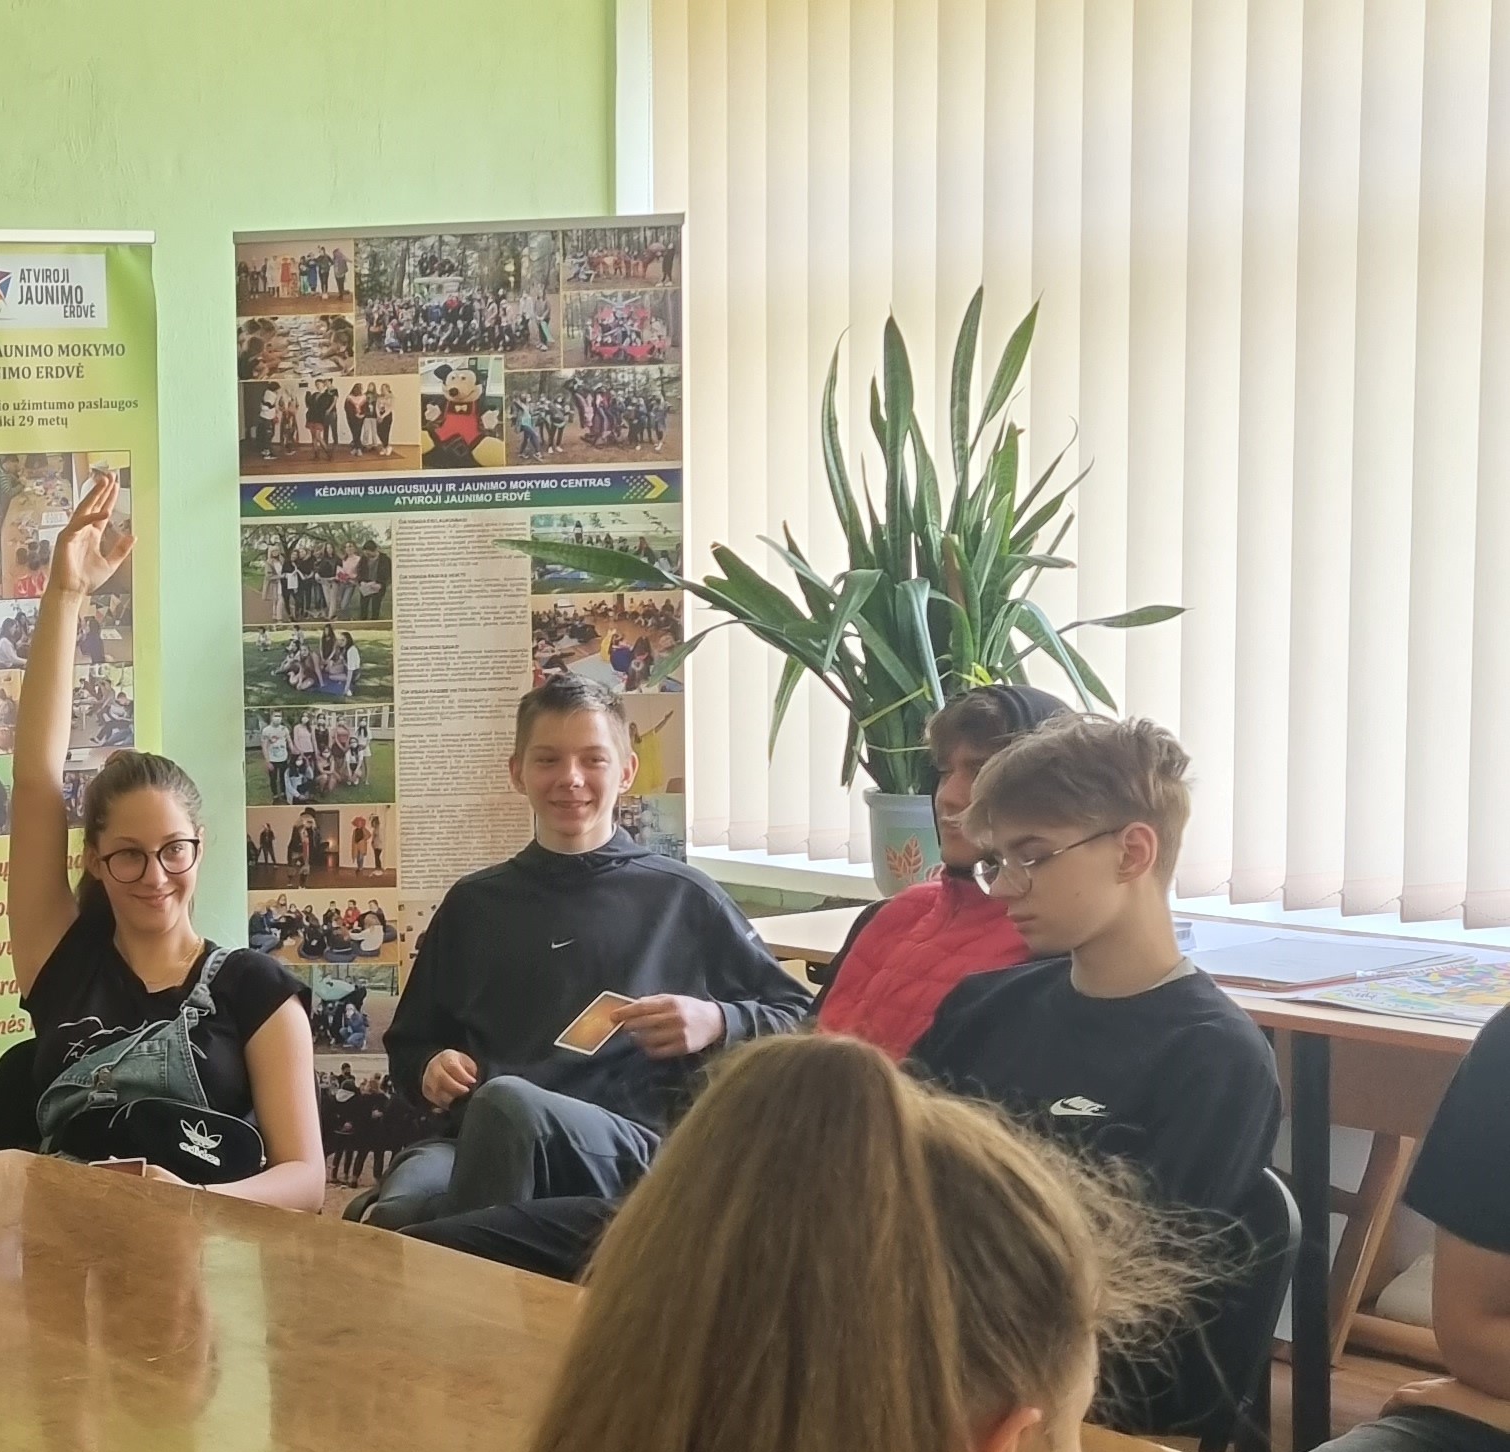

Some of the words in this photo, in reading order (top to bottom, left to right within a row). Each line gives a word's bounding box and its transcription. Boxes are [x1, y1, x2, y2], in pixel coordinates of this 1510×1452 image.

[19, 268, 69, 284] ATVIROJI
[18, 285, 83, 306] JAUNIMO
[63, 303, 96, 318] ERDVĖ
[58, 343, 125, 357] MOKYMO
[36, 363, 85, 379] ERDVĖ
[13, 399, 74, 411] užimtumo
[78, 397, 138, 412] paslaugos
[0, 415, 15, 427] iki
[18, 415, 34, 427] 29
[38, 416, 68, 429] metų
[315, 485, 364, 499] KĖDAINIŲ
[367, 483, 441, 496] SUAUGUSIŲJŲ
[445, 483, 456, 493] IR
[459, 481, 506, 493] JAUNIMO
[510, 479, 558, 490] MOKYMO
[560, 478, 611, 489] CENTRAS
[394, 495, 443, 506] ATVIROJI
[445, 493, 492, 504] JAUNIMO
[495, 490, 531, 502] ERDVĖ
